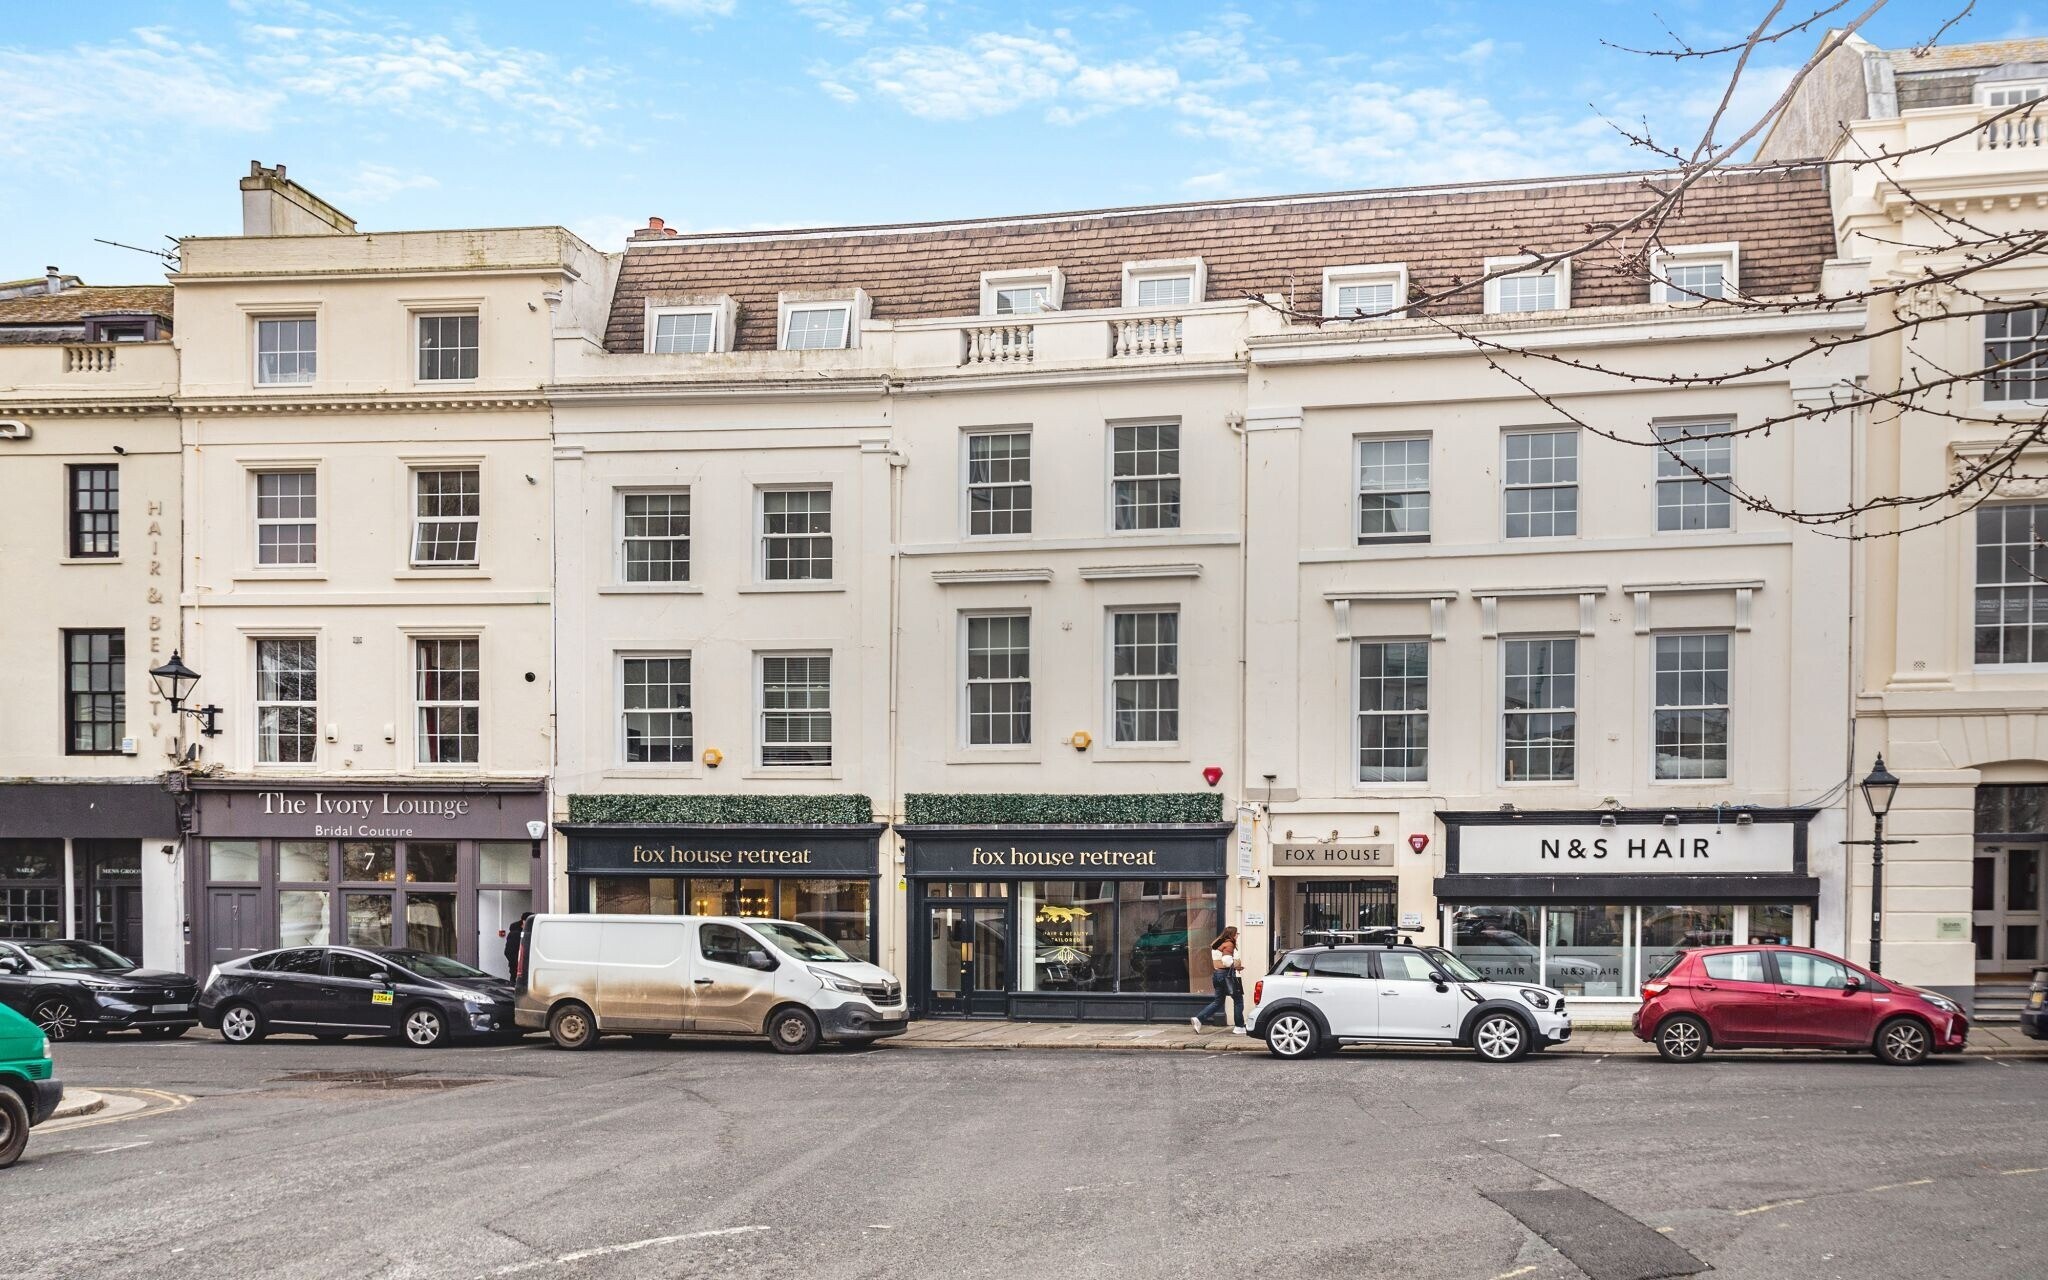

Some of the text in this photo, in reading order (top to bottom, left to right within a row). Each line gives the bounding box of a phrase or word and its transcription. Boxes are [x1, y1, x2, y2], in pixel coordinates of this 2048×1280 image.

[148, 501, 162, 576] HAIR
[147, 587, 162, 604] &
[258, 792, 469, 820] The Ivory Lounge
[315, 825, 413, 836] Bridal Couture
[632, 845, 812, 864] fox house retreat
[971, 847, 1156, 866] fox house retreat
[1285, 849, 1381, 861] FOX HOUSE
[1541, 838, 1709, 859] N&S HAIR
[364, 852, 376, 871] 7
[1497, 967, 1525, 975] HAIR
[1591, 968, 1620, 976] HAIR
